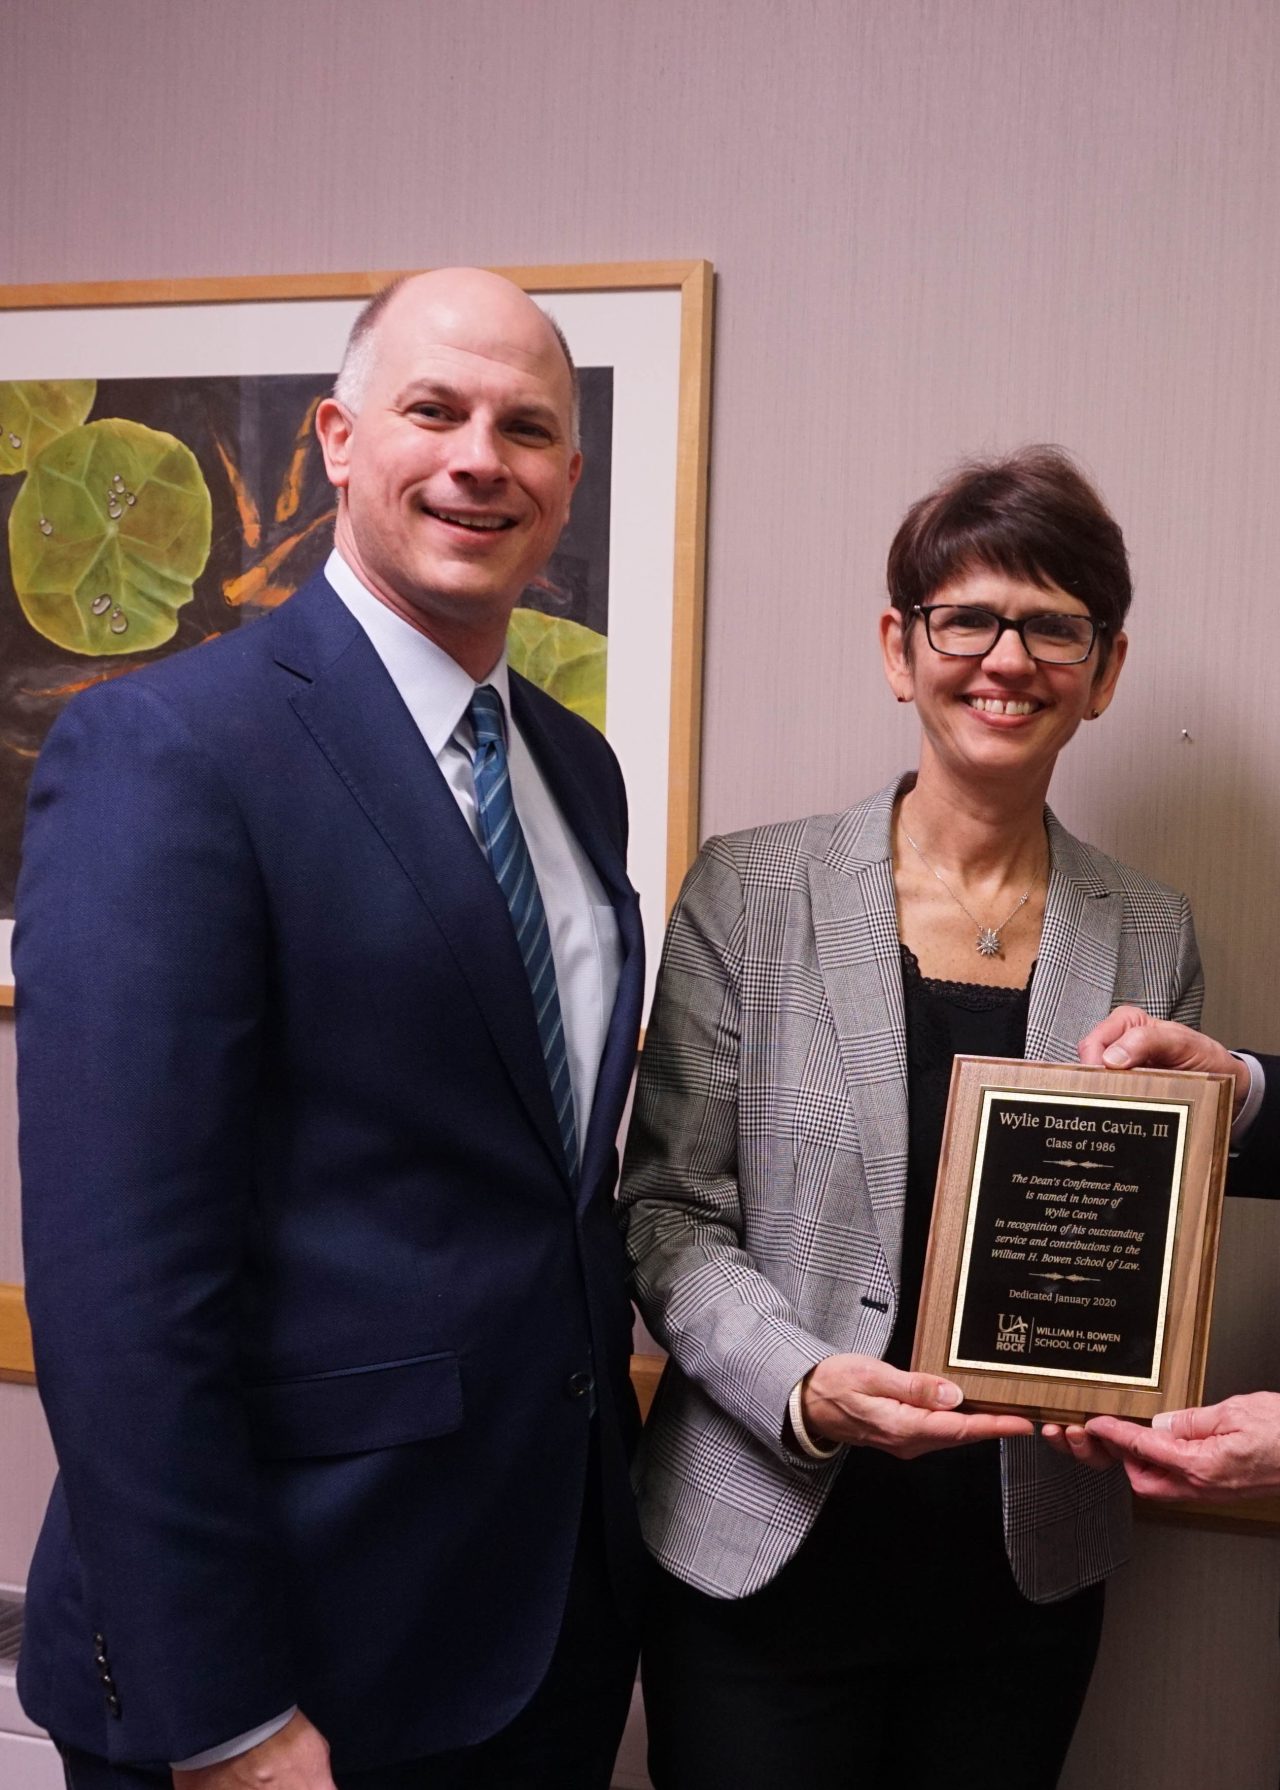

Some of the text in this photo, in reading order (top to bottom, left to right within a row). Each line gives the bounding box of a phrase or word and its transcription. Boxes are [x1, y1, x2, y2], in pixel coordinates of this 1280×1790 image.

[999, 1112, 1168, 1137] Wylie Darden Cavin, III
[1046, 1138, 1115, 1152] Class of 1986
[1011, 1174, 1138, 1192] The Dean's Conference Room
[1026, 1191, 1122, 1208] is named in honor of
[1045, 1208, 1098, 1220] Wylie Cavin
[995, 1218, 1144, 1240] in recognition of his outstanding
[995, 1235, 1140, 1255] service and contributions to the
[991, 1249, 1140, 1270] William H. Bowen School of Law.
[1009, 1290, 1116, 1307] Dedicated January 2020
[998, 1314, 1029, 1333] UA
[997, 1333, 1026, 1343] LITTLE
[1037, 1326, 1120, 1342] WILLIAM H. BOWEN
[996, 1342, 1024, 1352] ROCK
[1035, 1338, 1107, 1352] SCHOOL OF LAW
